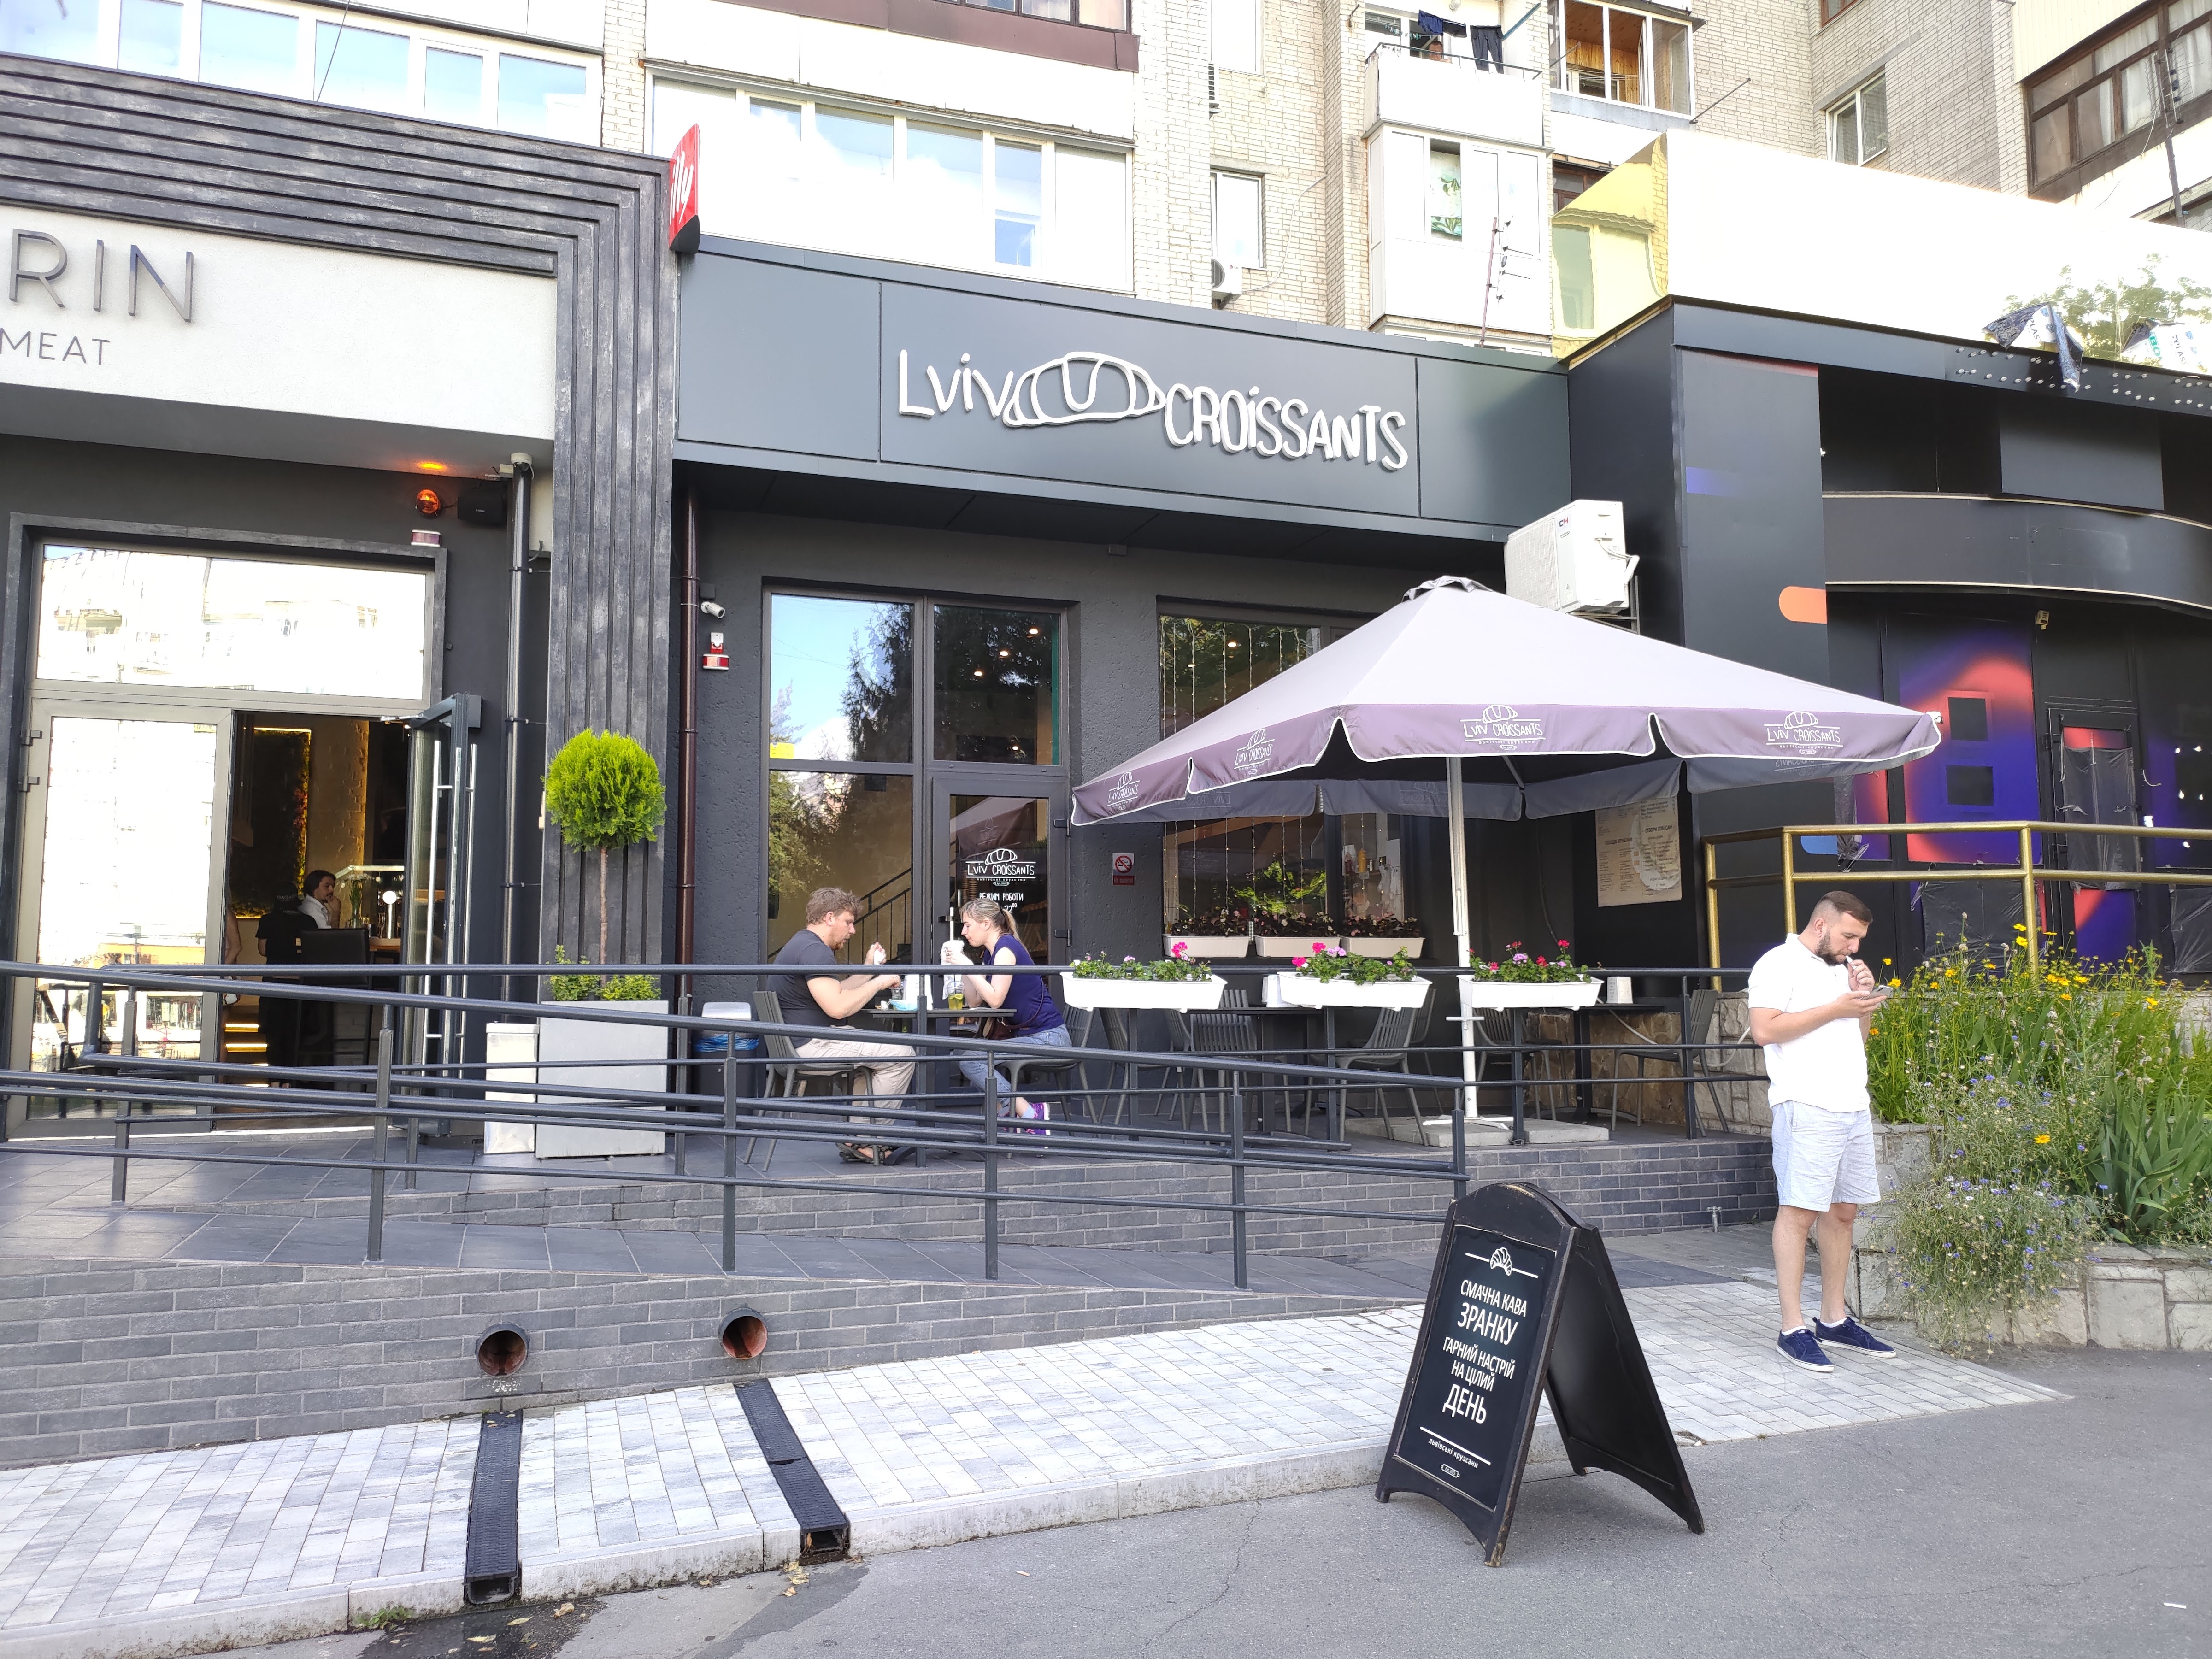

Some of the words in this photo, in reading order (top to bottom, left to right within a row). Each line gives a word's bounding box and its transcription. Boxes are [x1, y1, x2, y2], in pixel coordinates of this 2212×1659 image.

[670, 151, 694, 225] illy
[0, 328, 110, 365] MEAT
[1559, 517, 1569, 527] CH
[1002, 893, 1024, 901] РОБОТИ
[1460, 1279, 1500, 1307] СМАЧНА
[1501, 1294, 1527, 1317] КАВА
[1457, 1302, 1518, 1345] ЗРАНКУ
[1442, 1337, 1478, 1364] ГАРНИЙ
[1477, 1351, 1515, 1379] НАСТРІЙ
[1451, 1360, 1465, 1379] НА
[1465, 1368, 1495, 1392] ЦІЛИЙ
[1442, 1383, 1487, 1424] ДЕНЬ
[1428, 1438, 1453, 1455] львівські
[1453, 1451, 1478, 1469] круасани
